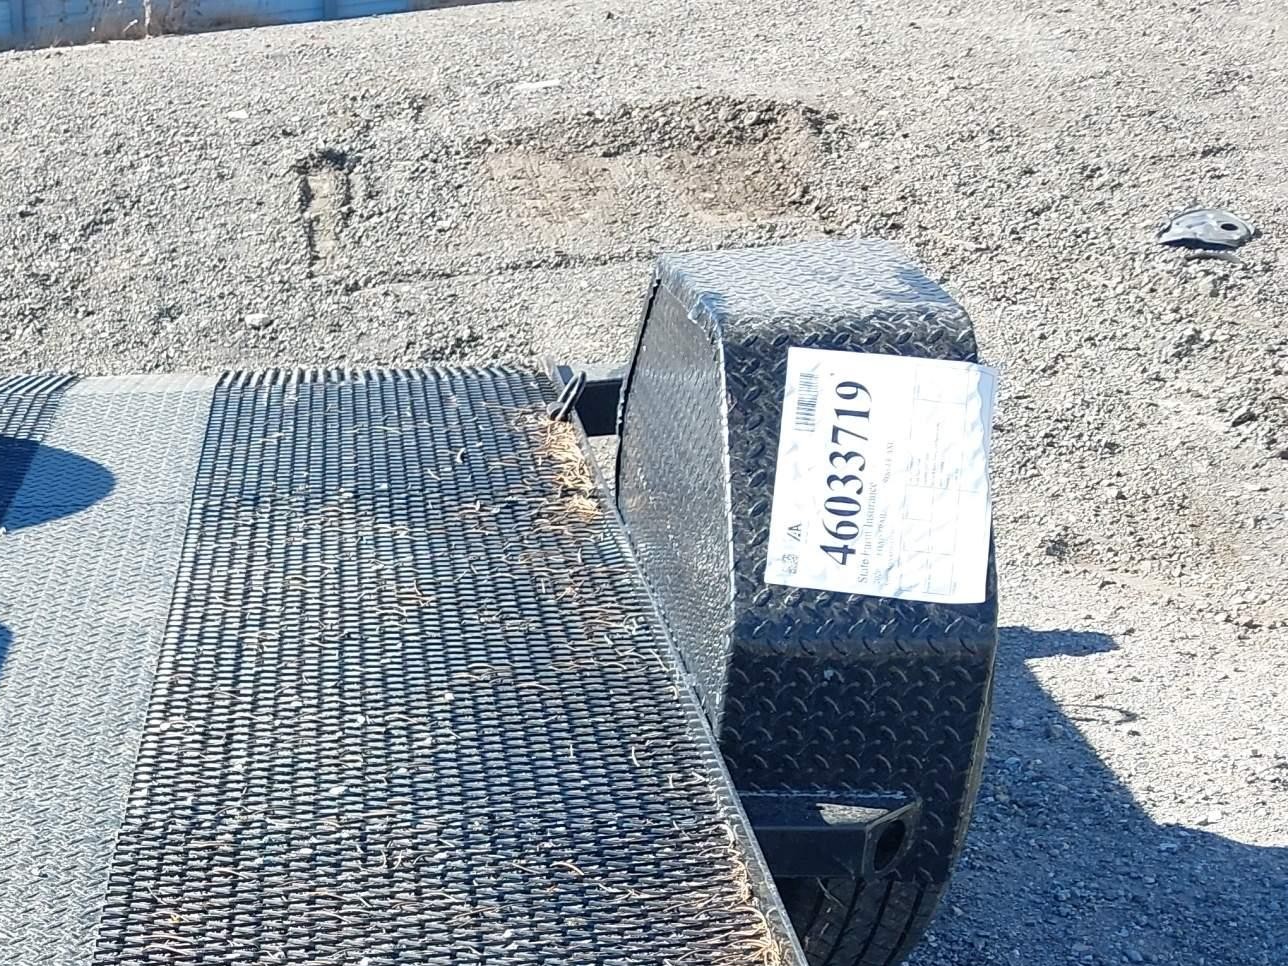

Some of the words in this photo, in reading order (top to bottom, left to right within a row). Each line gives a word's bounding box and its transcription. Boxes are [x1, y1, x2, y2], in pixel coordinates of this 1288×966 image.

[820, 381, 872, 566] 46033719
[857, 557, 871, 584] State
[865, 481, 878, 527] Insurance
